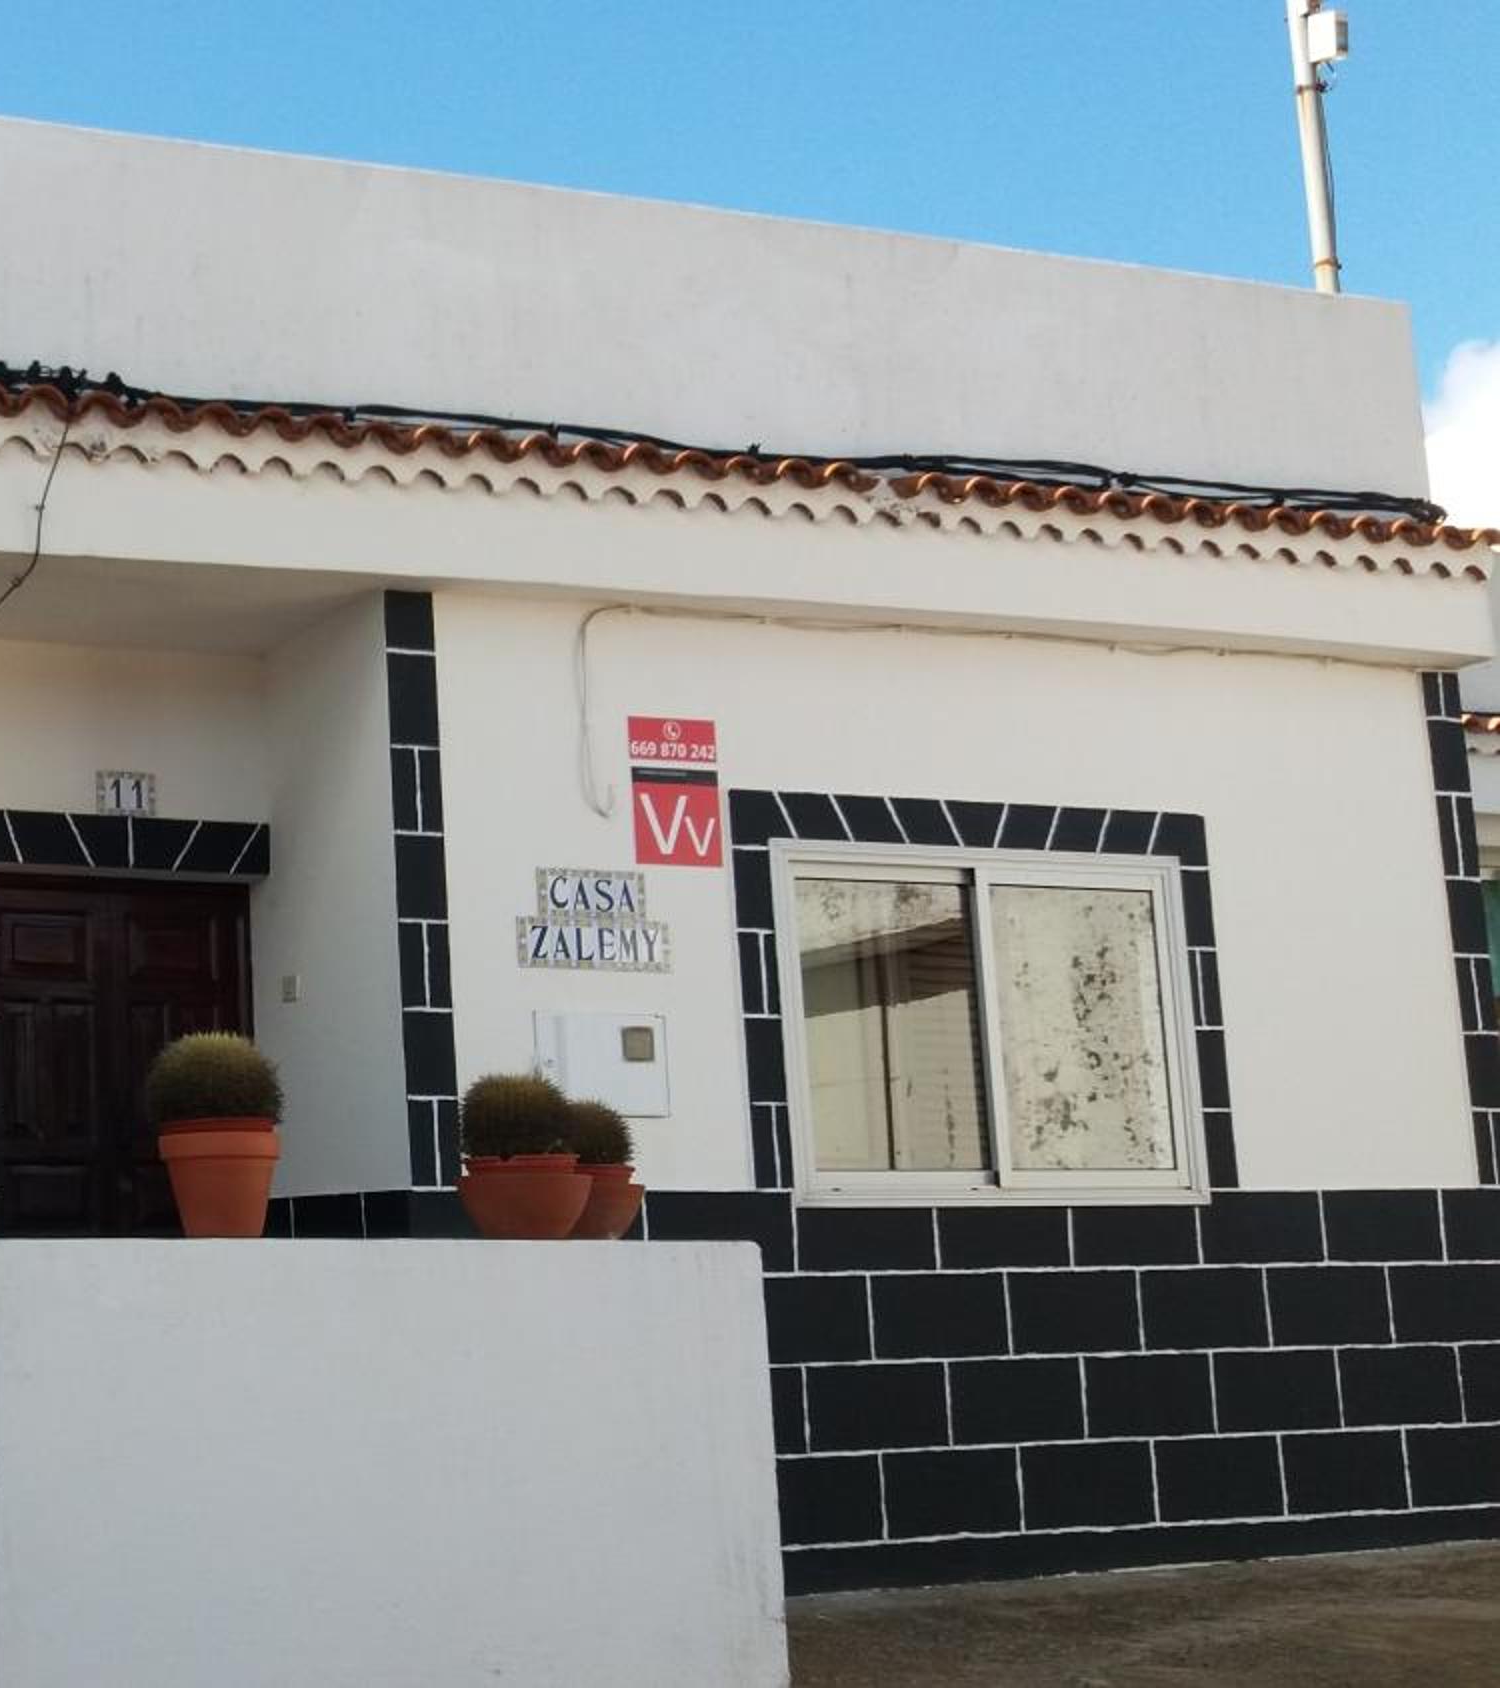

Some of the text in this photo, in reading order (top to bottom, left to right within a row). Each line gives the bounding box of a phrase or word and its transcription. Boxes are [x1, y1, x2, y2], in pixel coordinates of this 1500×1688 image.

[631, 741, 715, 760] 669 870 242
[110, 779, 142, 808] 11
[550, 875, 635, 913] CASA
[530, 925, 659, 963] ZALEMY
